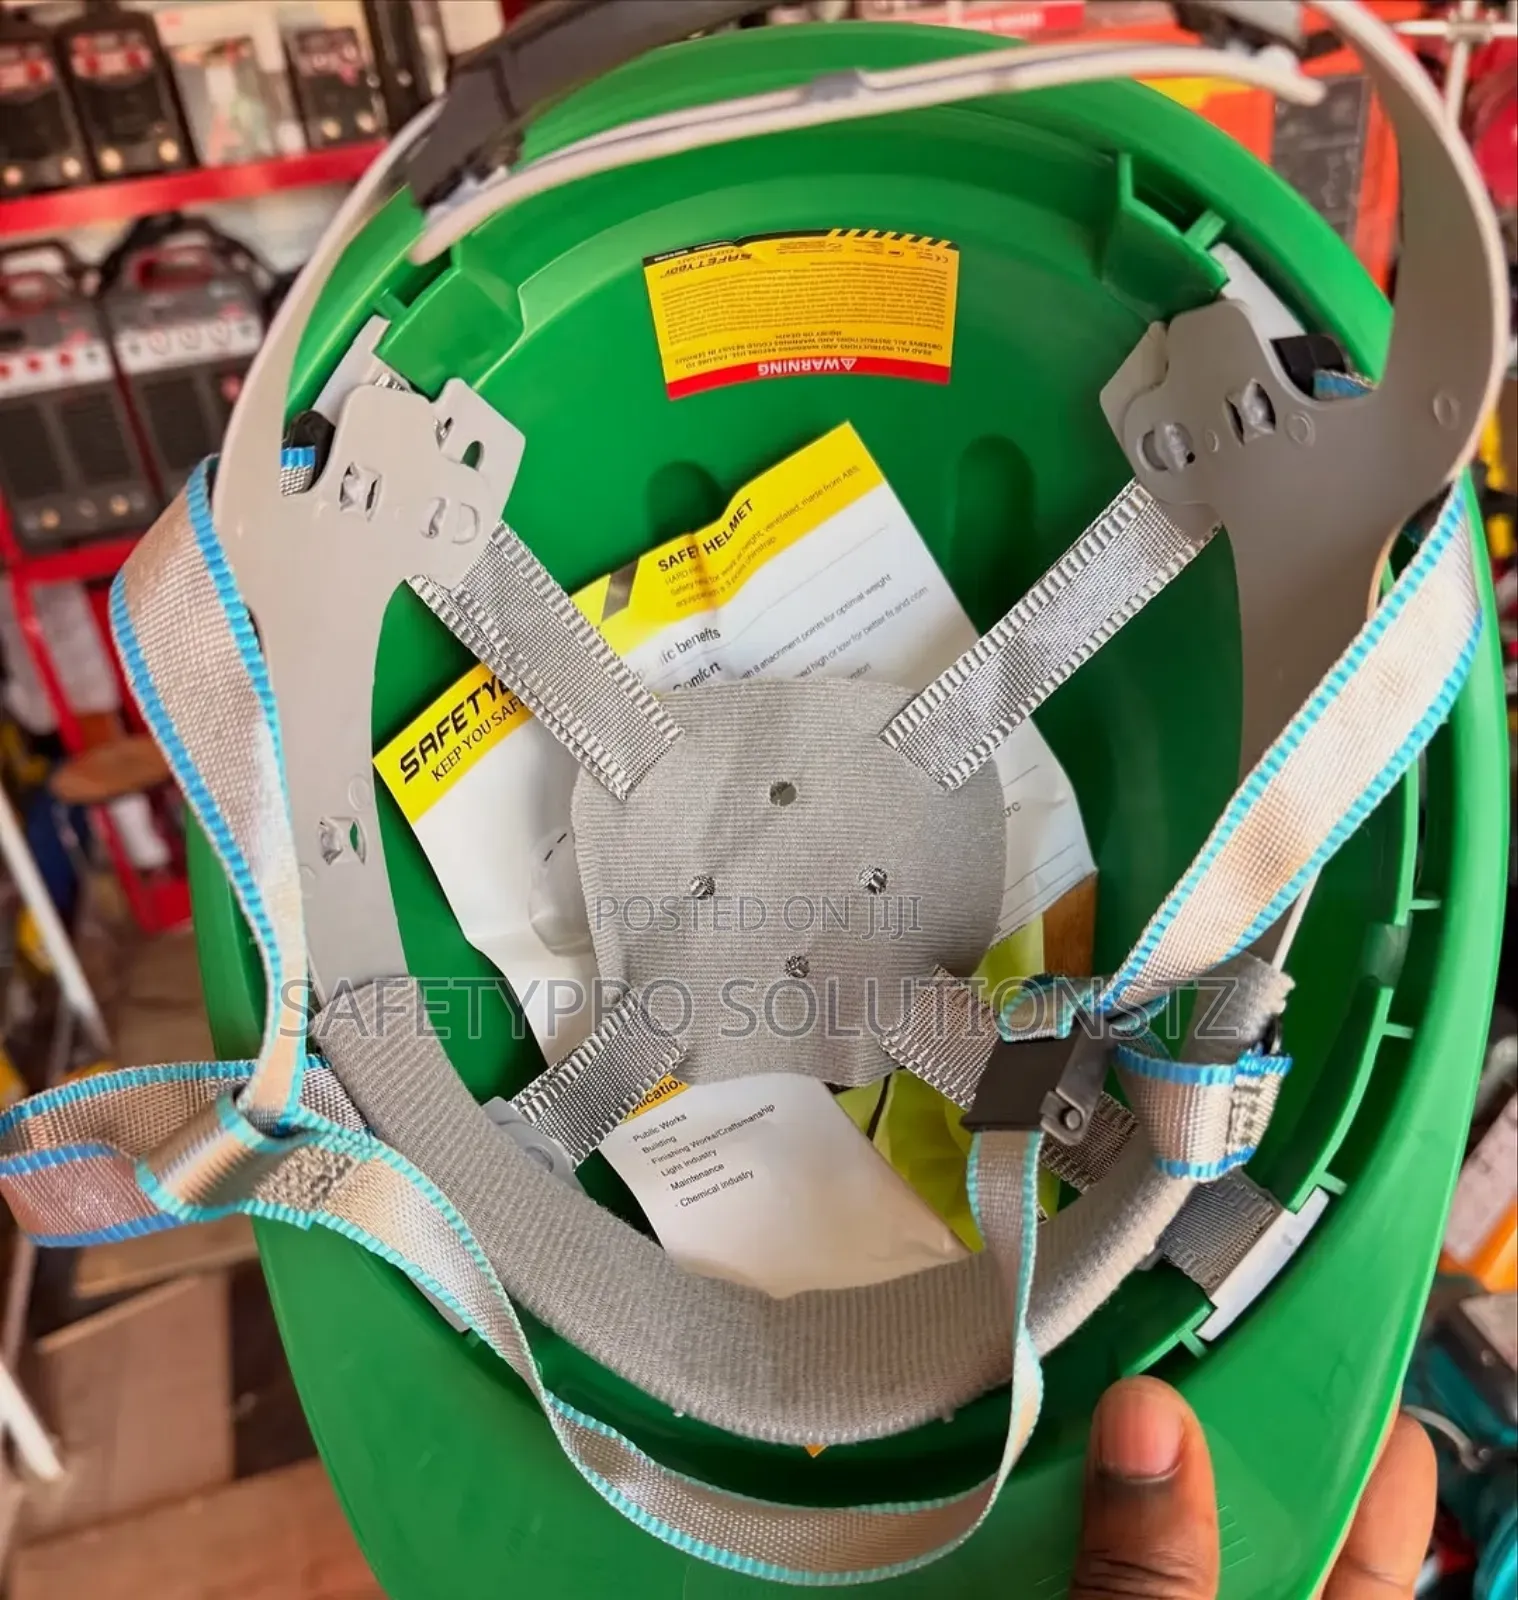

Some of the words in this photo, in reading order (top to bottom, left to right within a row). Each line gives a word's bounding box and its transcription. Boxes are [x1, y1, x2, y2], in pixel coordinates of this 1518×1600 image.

[757, 357, 841, 377] WARNING
[702, 498, 754, 556] HELMET
[759, 636, 801, 669] attachment
[801, 620, 826, 642] points
[823, 613, 836, 625] for
[835, 592, 865, 617] optimal
[865, 574, 893, 597] weight
[674, 626, 722, 653] benefts
[810, 653, 830, 672] high
[431, 746, 463, 782] KEEP
[462, 719, 492, 751] YOU
[632, 1125, 660, 1143] Public
[659, 1113, 688, 1130] Works
[651, 1143, 691, 1165] Finishing
[689, 1103, 776, 1148] Works/Craftsmanship
[641, 1135, 678, 1154] Building
[660, 1162, 683, 1178] Light
[669, 1163, 725, 1192] Maintenance
[680, 1183, 721, 1208] Chemical
